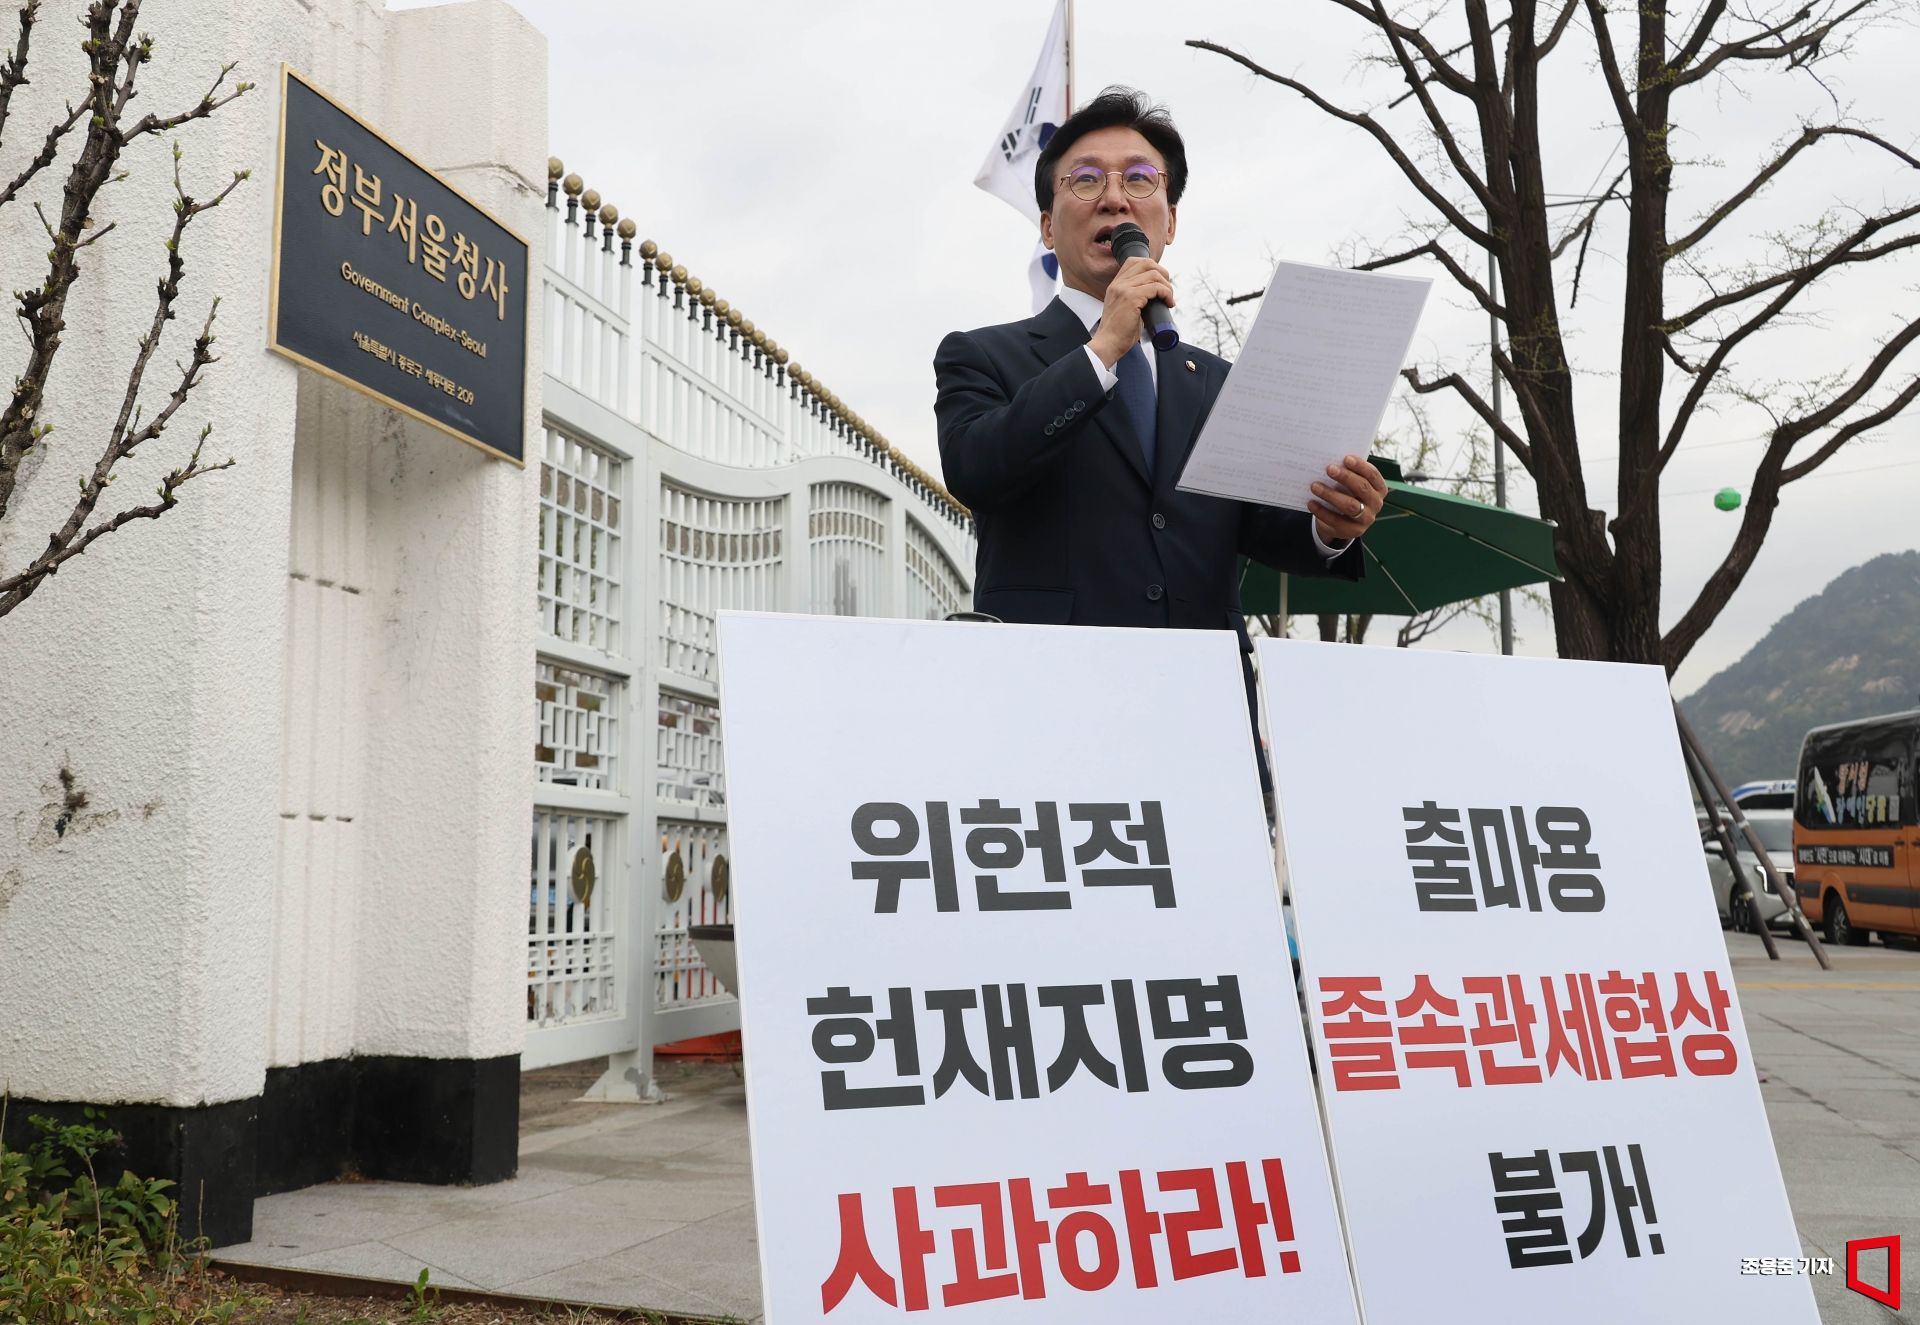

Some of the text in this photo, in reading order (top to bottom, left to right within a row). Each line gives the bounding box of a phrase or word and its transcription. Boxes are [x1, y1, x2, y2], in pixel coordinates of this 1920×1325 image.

[313, 138, 510, 321] 정부서울청사
[341, 262, 487, 359] Government Complex-Seoul
[352, 331, 475, 405] 서울특별시 종로구 세종대로 209
[851, 799, 1177, 913] 위헌적
[1402, 801, 1606, 913] 출마용
[806, 974, 1255, 1111] 헌재지명
[1318, 970, 1738, 1092] 졸속관세협상
[821, 1158, 1302, 1315] 사과하라!
[1488, 1143, 1666, 1270] 불가!
